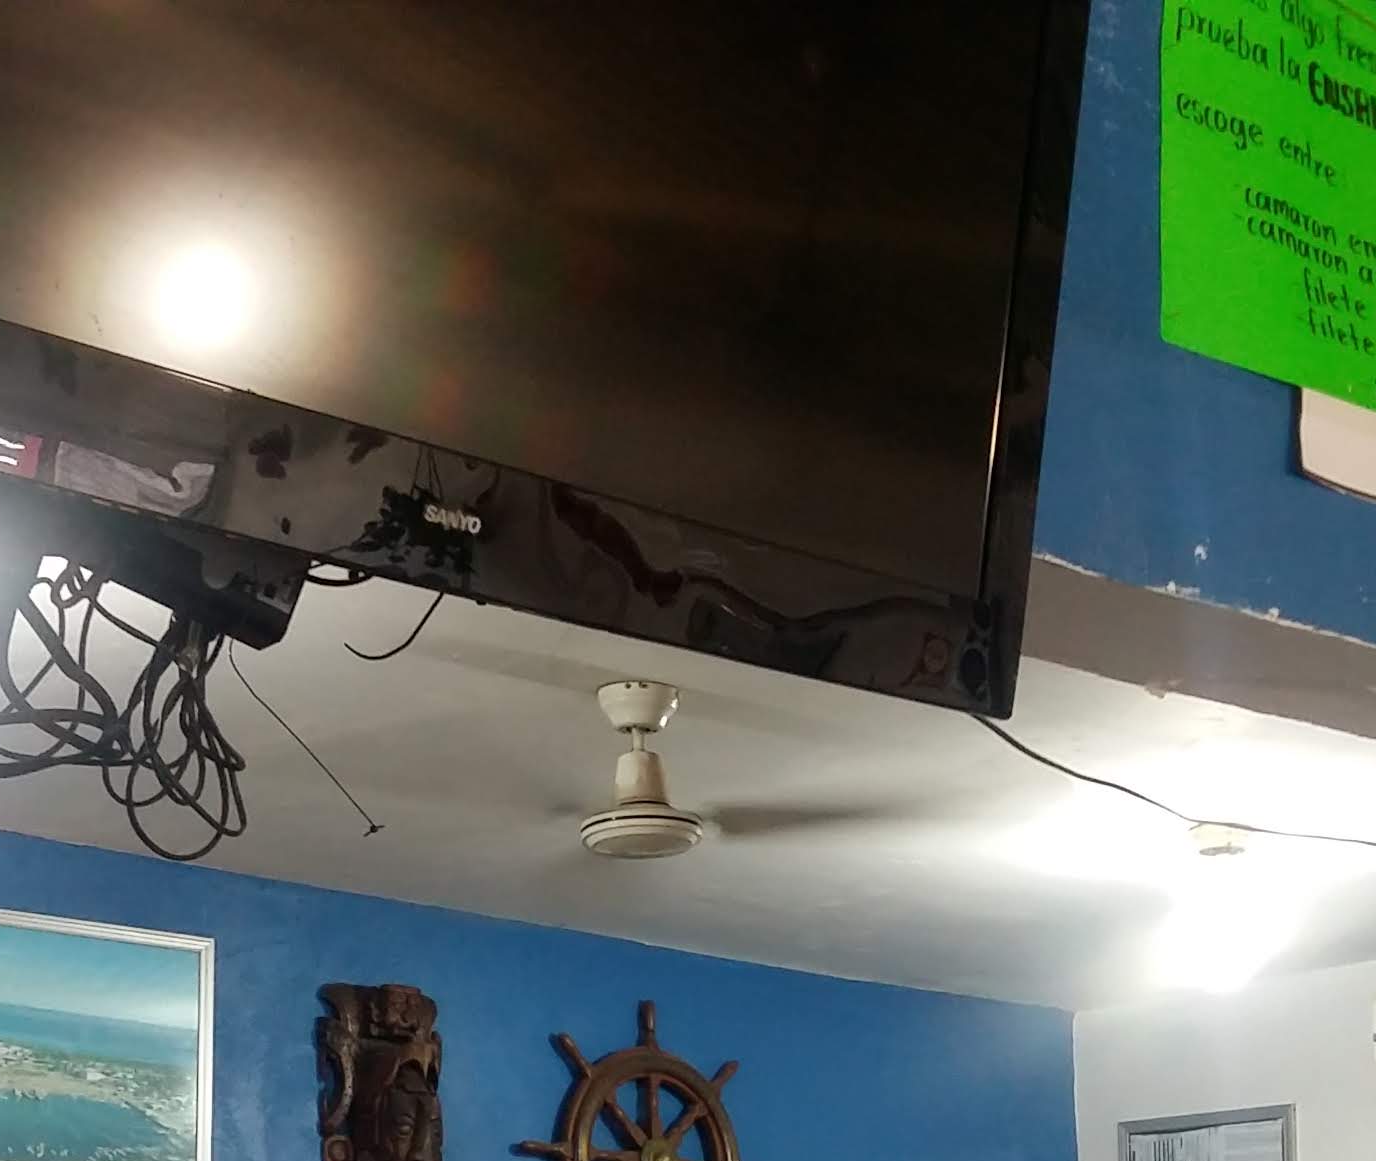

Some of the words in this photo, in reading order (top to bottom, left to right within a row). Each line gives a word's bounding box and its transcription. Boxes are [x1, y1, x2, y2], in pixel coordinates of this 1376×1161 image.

[1176, 7, 1269, 71] prueba
[1280, 36, 1301, 85] la
[1176, 93, 1264, 151] escoge
[1280, 136, 1337, 187] entre
[1244, 187, 1338, 247] camaron
[1246, 216, 1349, 276] camaron
[1304, 266, 1368, 320] filete
[1308, 307, 1374, 354] filete
[424, 503, 482, 536] SANYO
